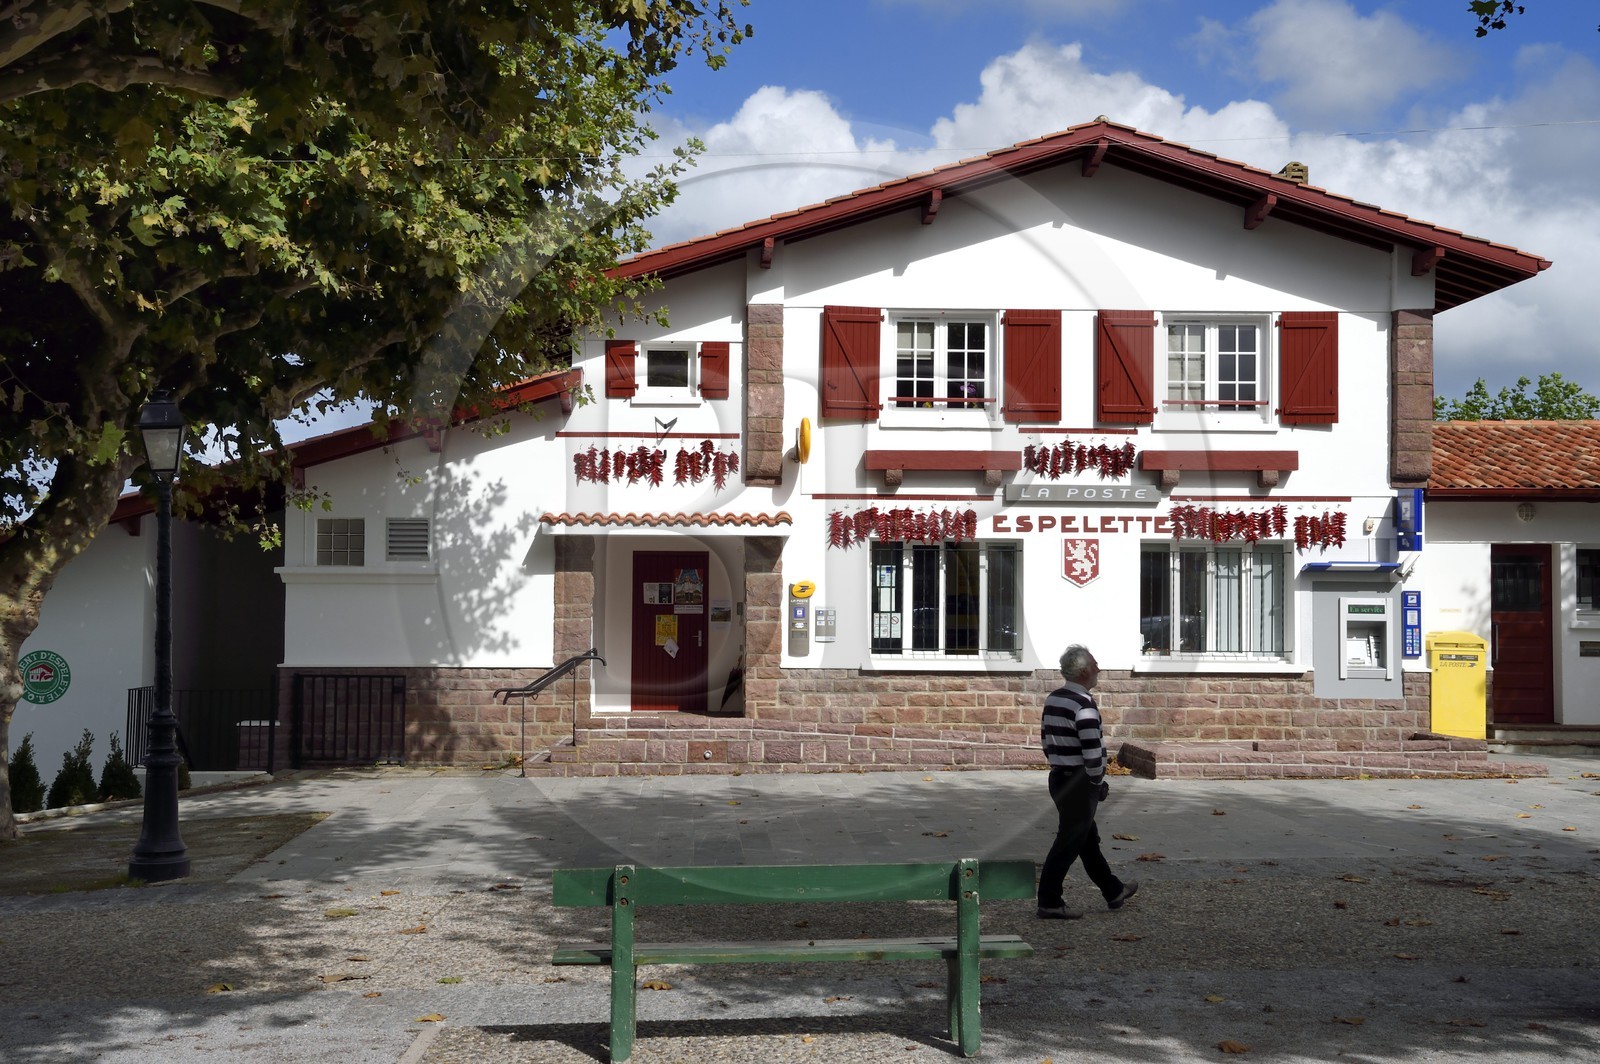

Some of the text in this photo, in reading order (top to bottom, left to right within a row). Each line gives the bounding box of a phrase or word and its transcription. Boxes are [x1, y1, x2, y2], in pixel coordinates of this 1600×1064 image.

[1020, 487, 1148, 499] LA POSTE
[992, 515, 1173, 534] ESPELETTE
[40, 651, 69, 702] D'ESPELETTE
